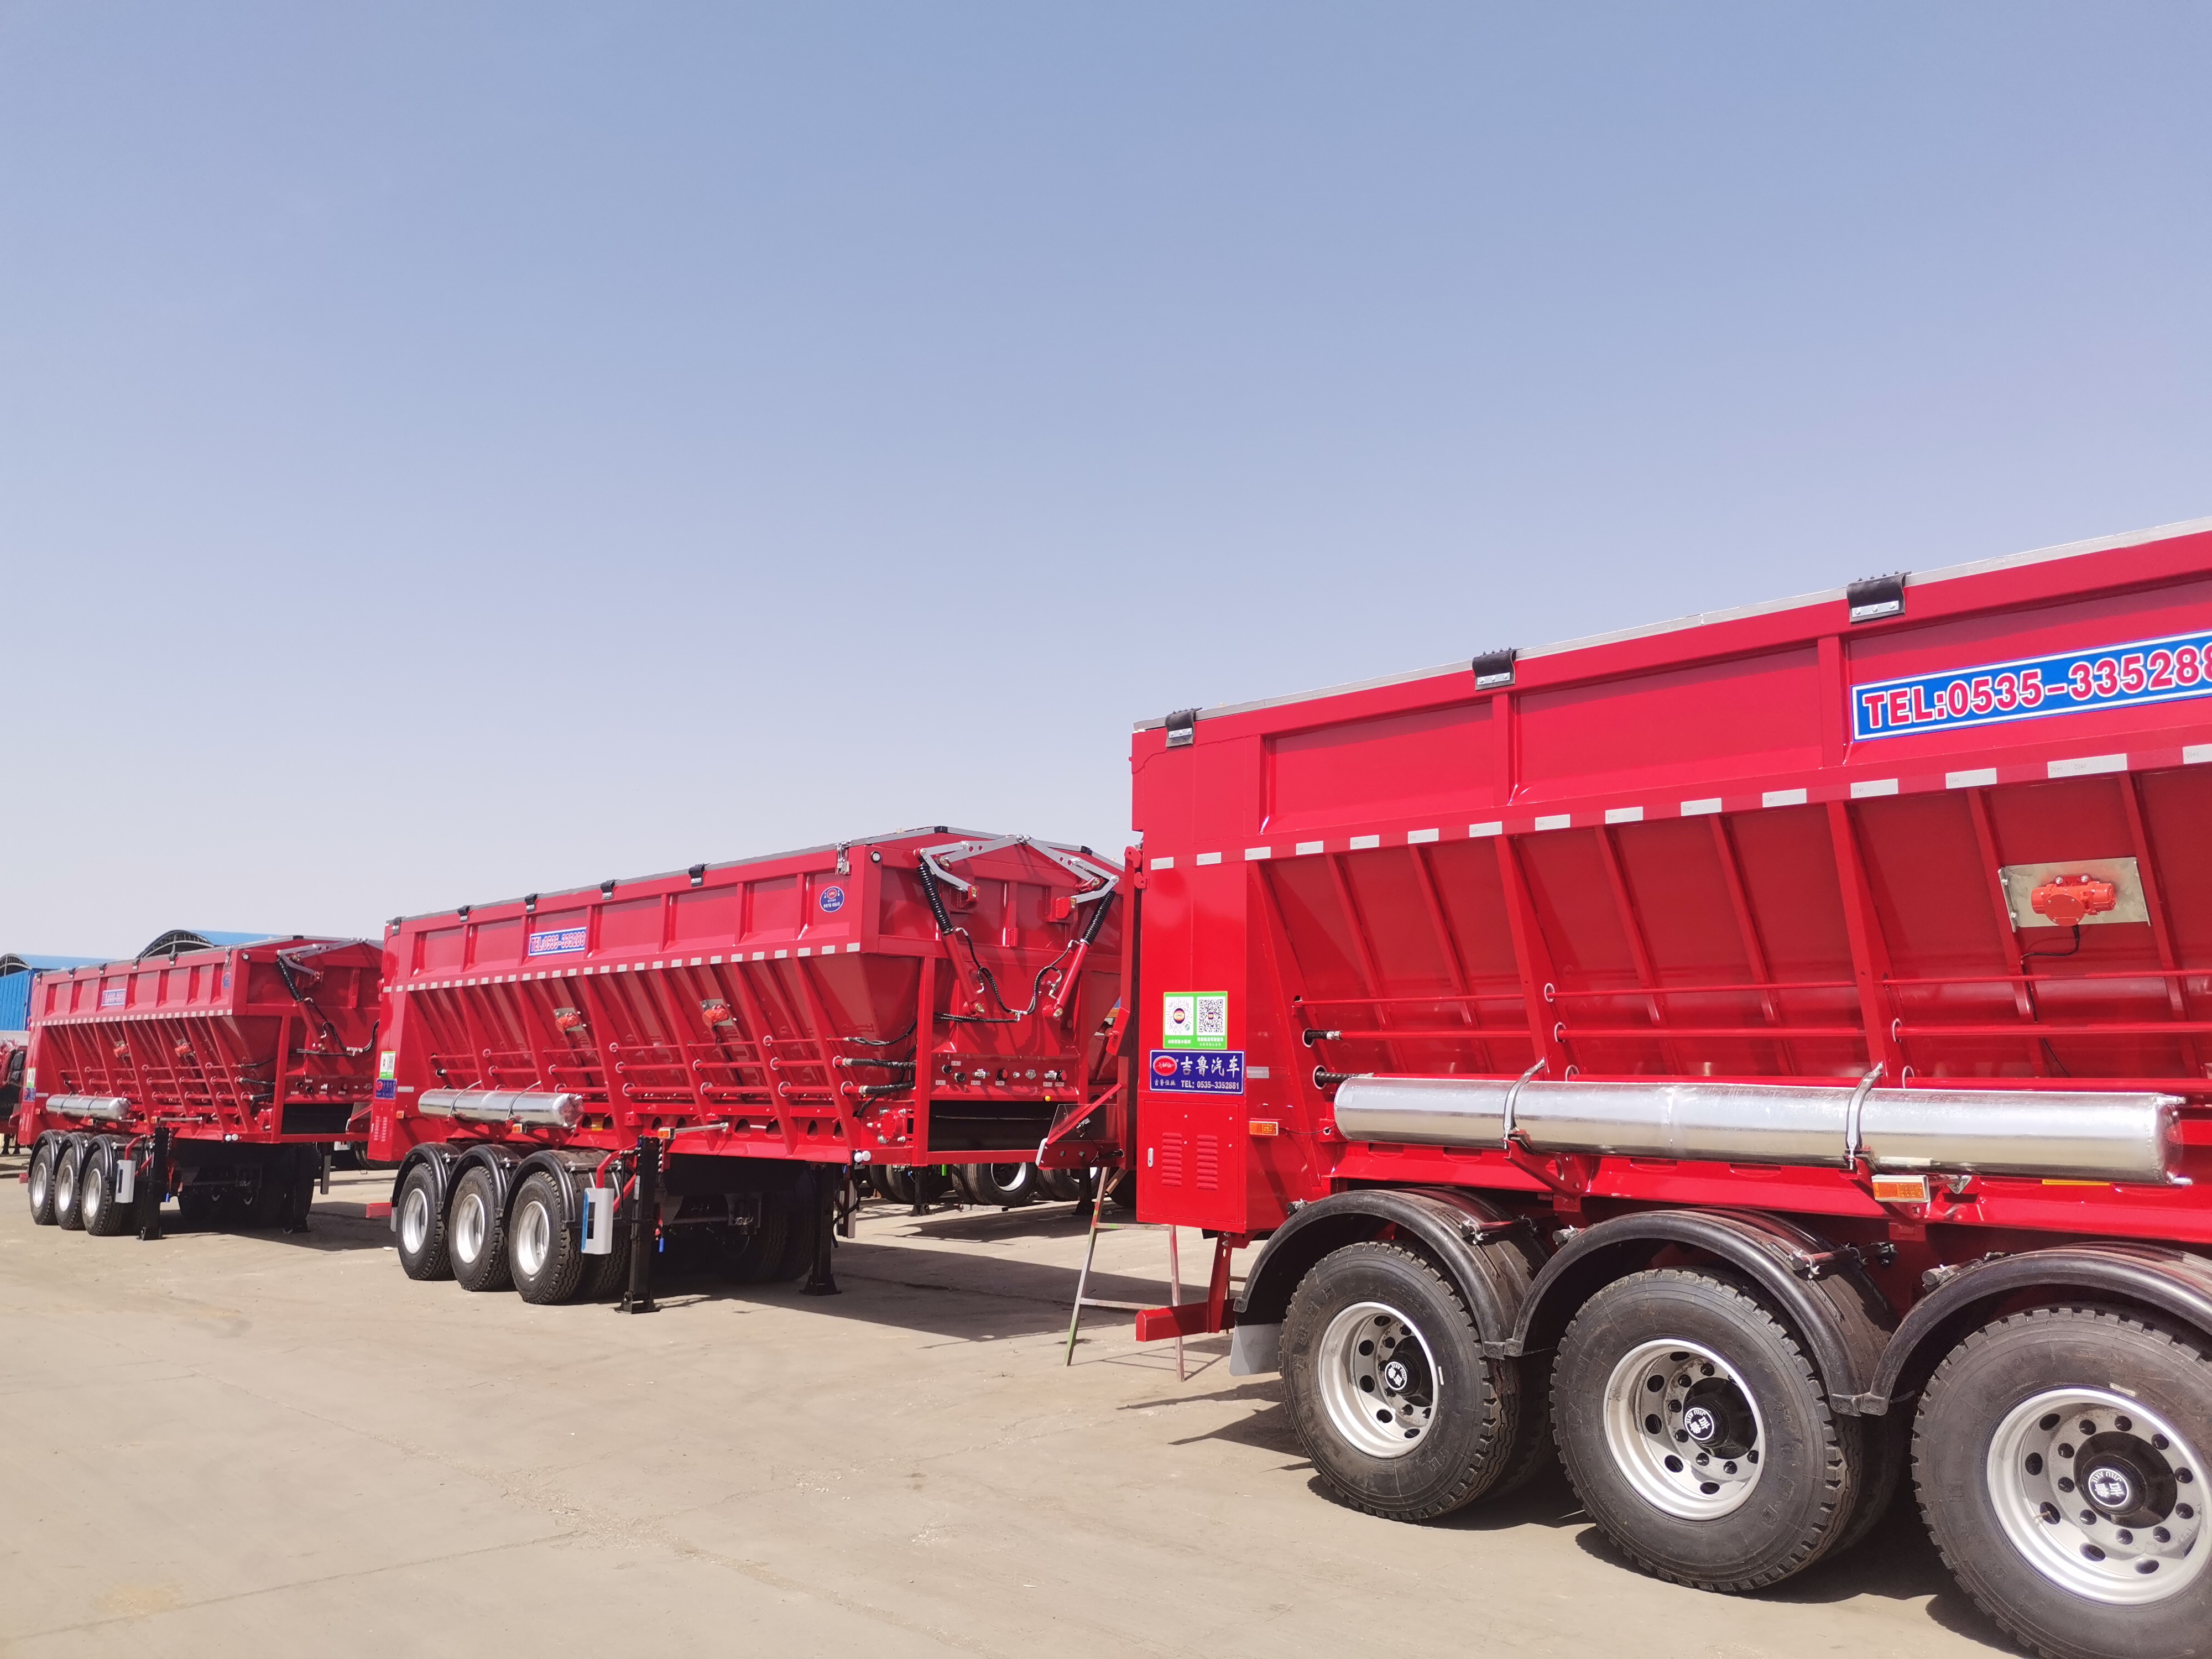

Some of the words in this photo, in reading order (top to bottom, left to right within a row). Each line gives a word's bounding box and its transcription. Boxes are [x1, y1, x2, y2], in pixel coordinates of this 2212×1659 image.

[1181, 1055, 1240, 1078] 吉鲁汽车
[1181, 1080, 1194, 1088] TEL:
[2091, 1471, 2104, 1484] AXLE
[2105, 1471, 2122, 1482] JILU
